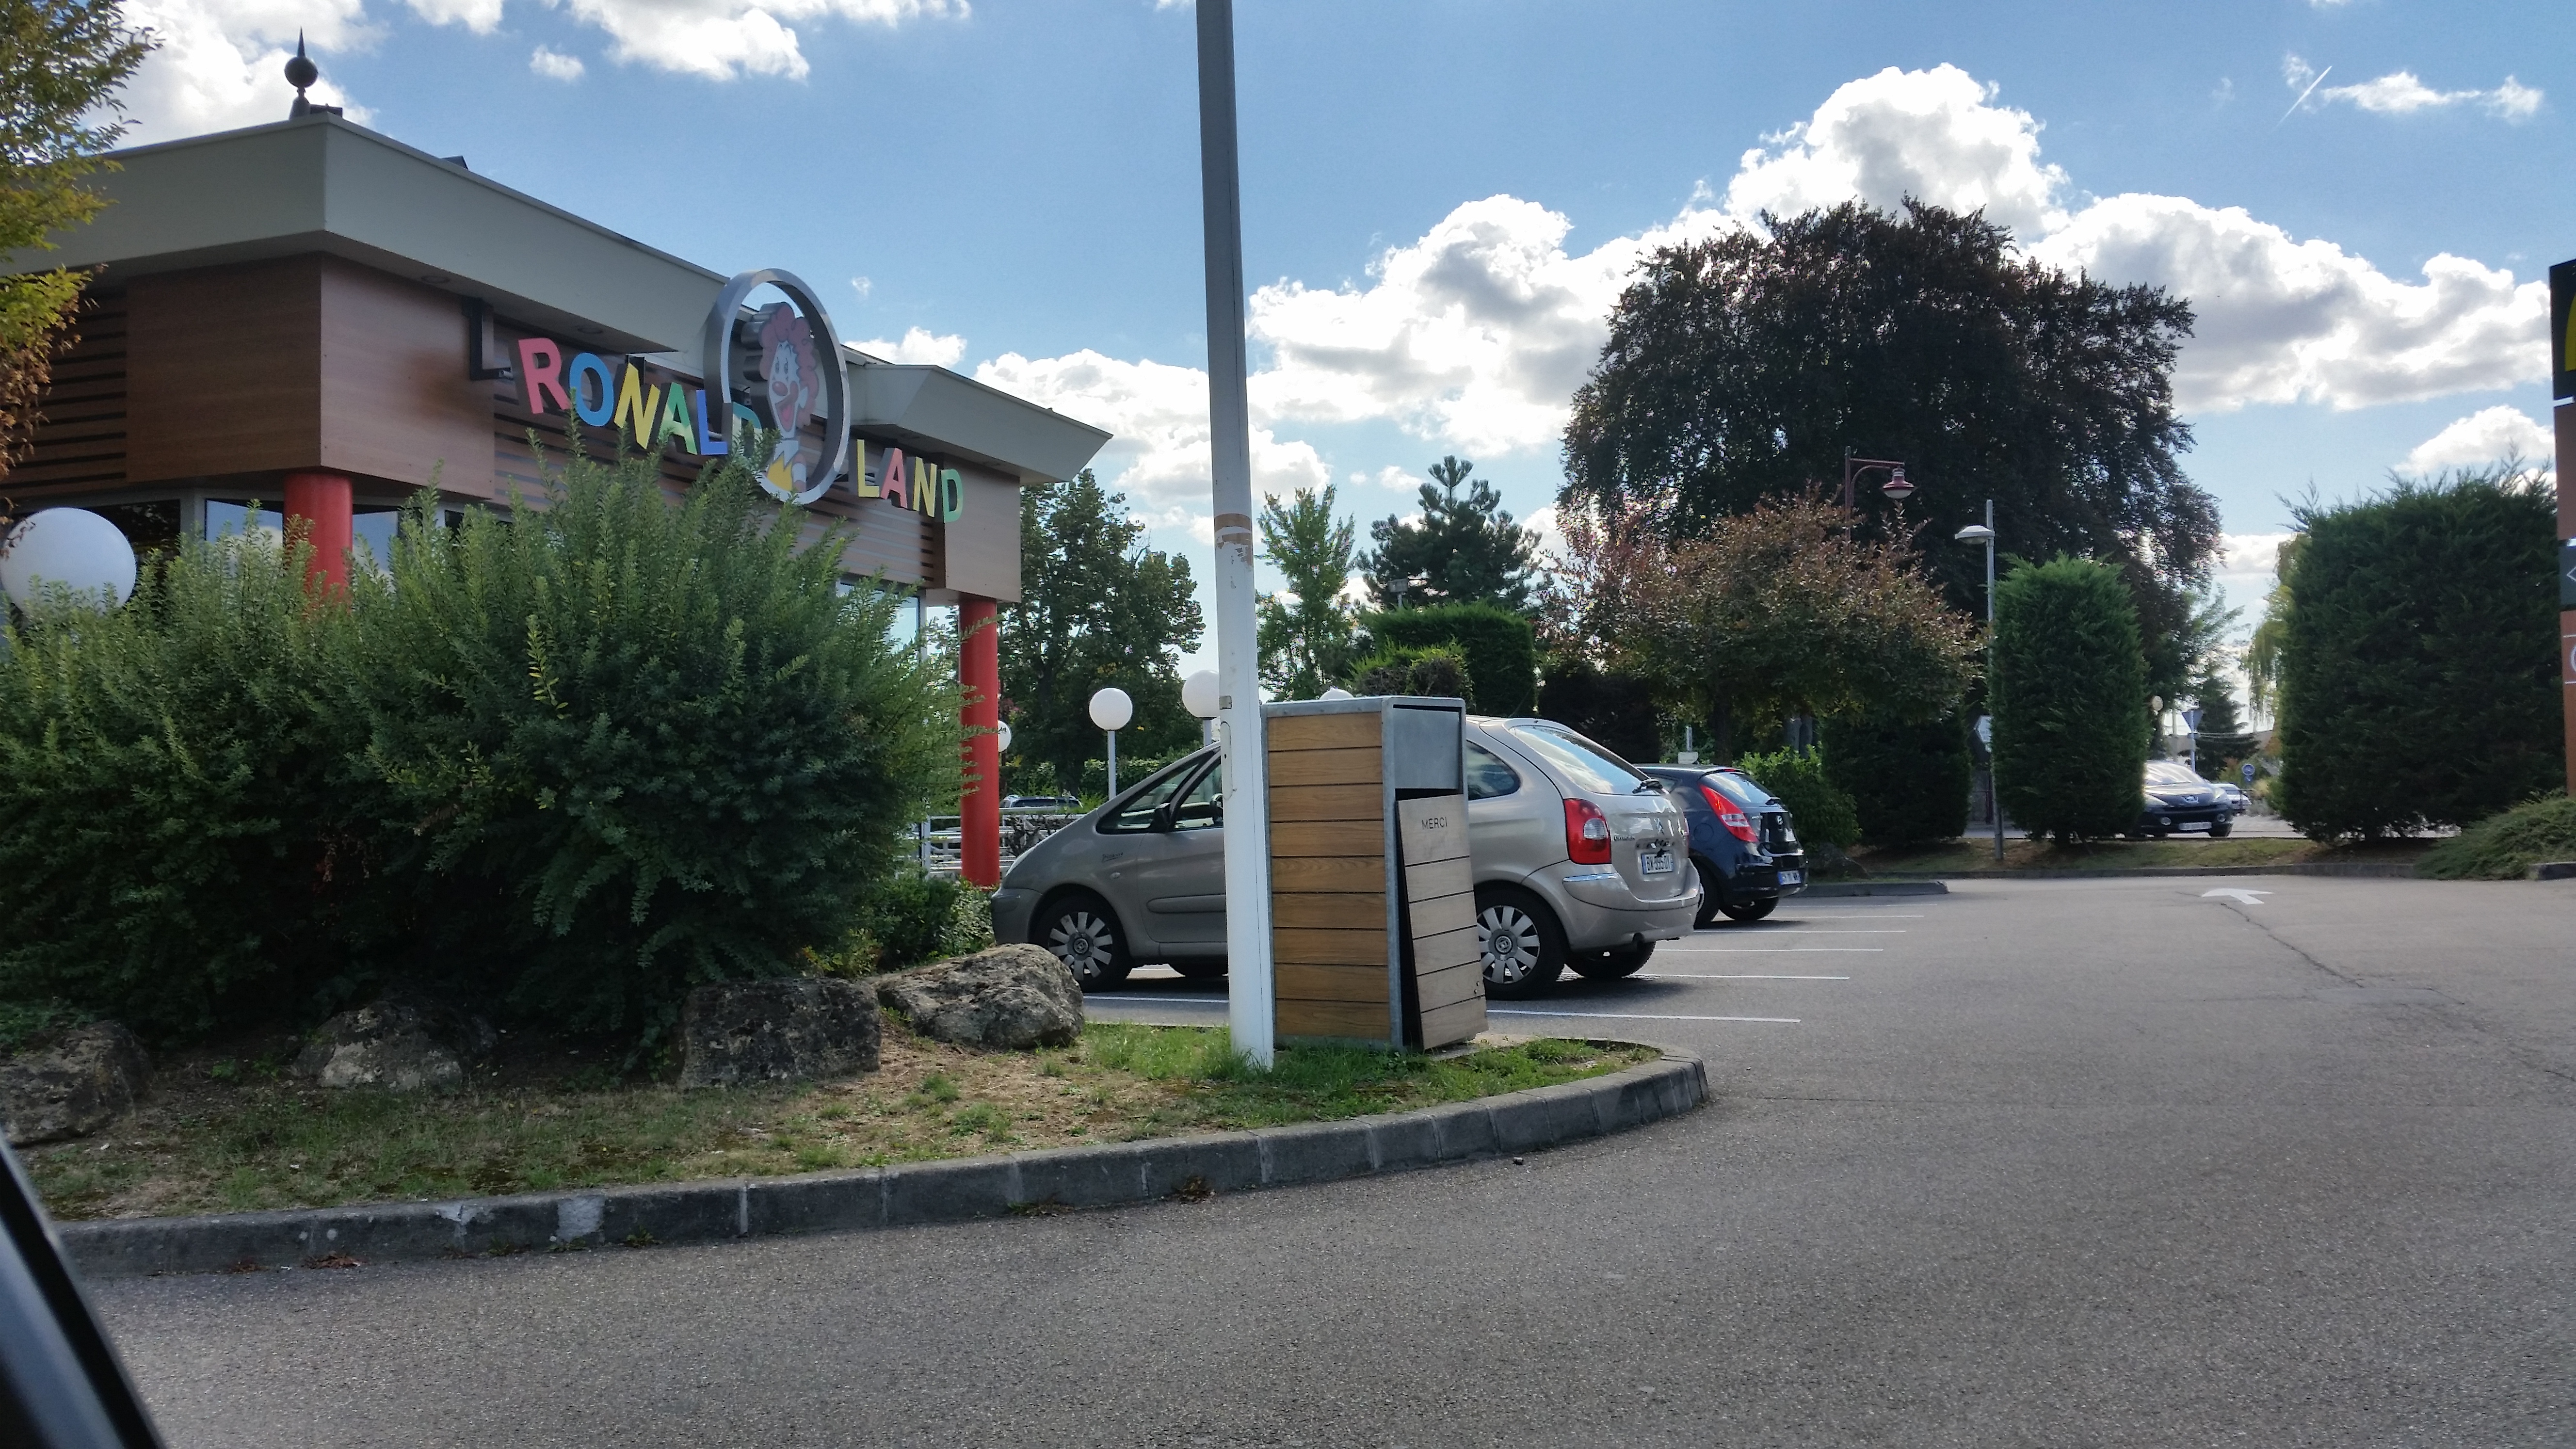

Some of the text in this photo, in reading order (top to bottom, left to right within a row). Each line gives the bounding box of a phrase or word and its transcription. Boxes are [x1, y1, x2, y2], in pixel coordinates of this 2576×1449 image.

[518, 338, 964, 523] RONALD LAND
[1421, 817, 1448, 830] MERCI
